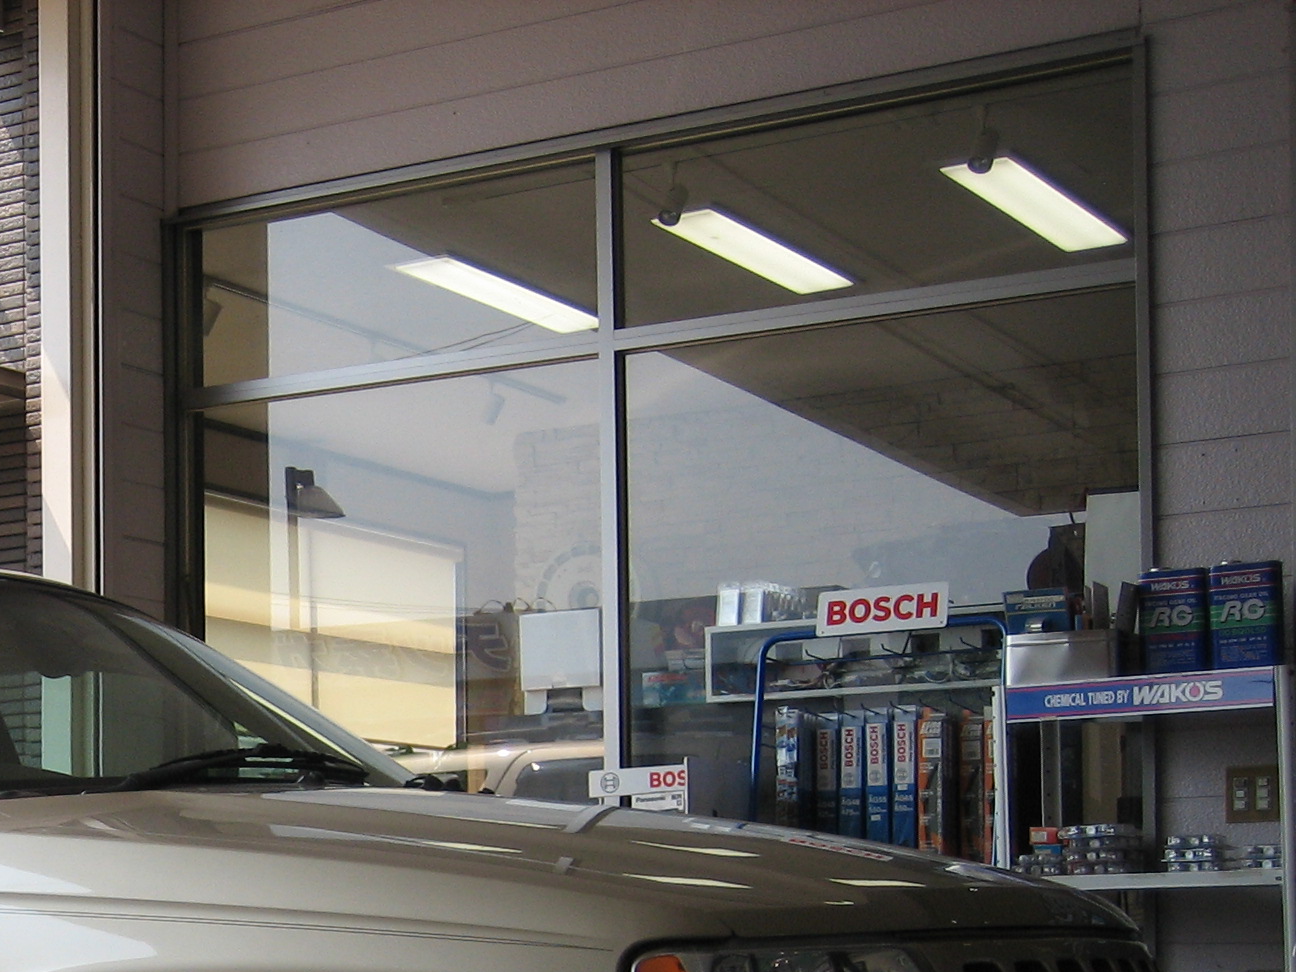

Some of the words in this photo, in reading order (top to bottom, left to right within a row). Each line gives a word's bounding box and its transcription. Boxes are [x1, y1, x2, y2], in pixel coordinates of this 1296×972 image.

[826, 592, 939, 626] BOSCH
[1148, 605, 1194, 629] RG
[1220, 598, 1266, 623] RG
[1044, 691, 1086, 708] CHEMICAL
[1087, 693, 1115, 706] TUNED
[1117, 689, 1131, 704] BY
[819, 731, 828, 770] BOSCH
[844, 728, 854, 767] BOSCH
[870, 725, 879, 764] BOSCH
[897, 723, 906, 763] BOSCH
